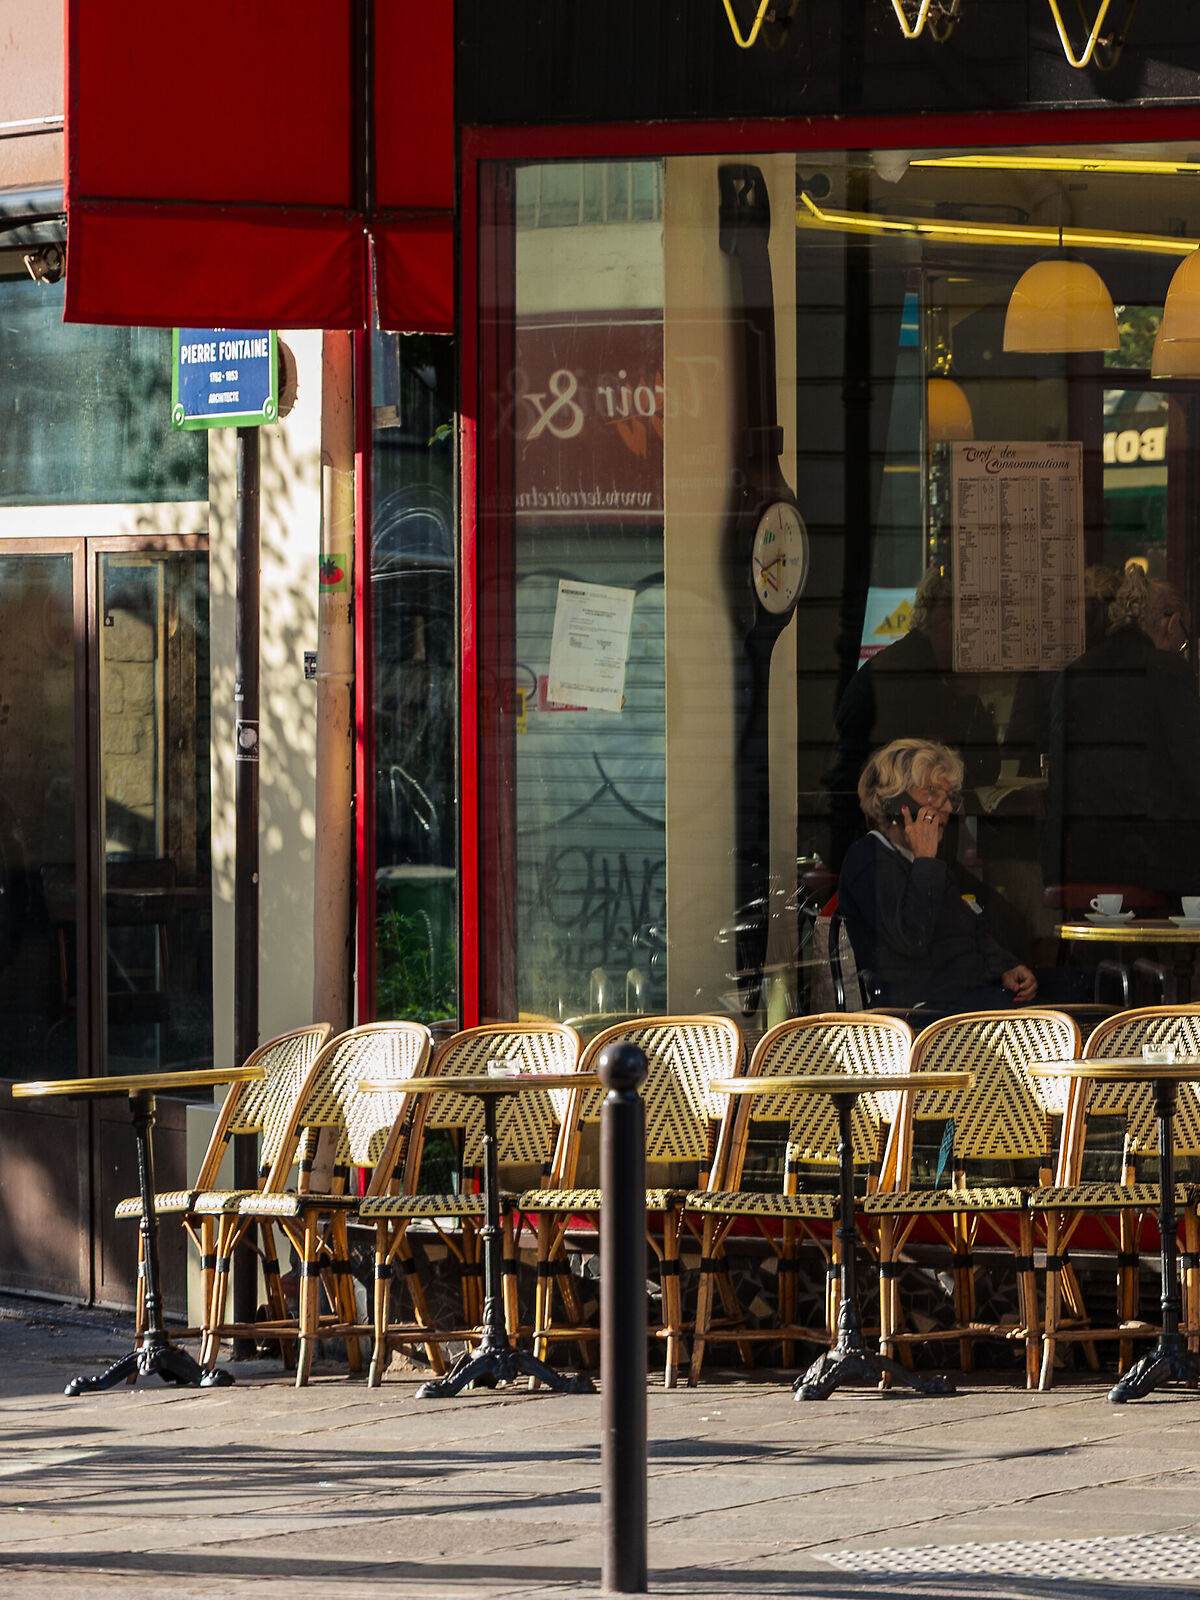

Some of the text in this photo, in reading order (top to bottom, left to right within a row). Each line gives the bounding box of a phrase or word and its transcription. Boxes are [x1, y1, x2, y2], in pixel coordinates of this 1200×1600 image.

[180, 338, 269, 365] PIERRE FONTAINE
[962, 445, 1017, 463] Tarif des
[985, 459, 1070, 474] Consommations
